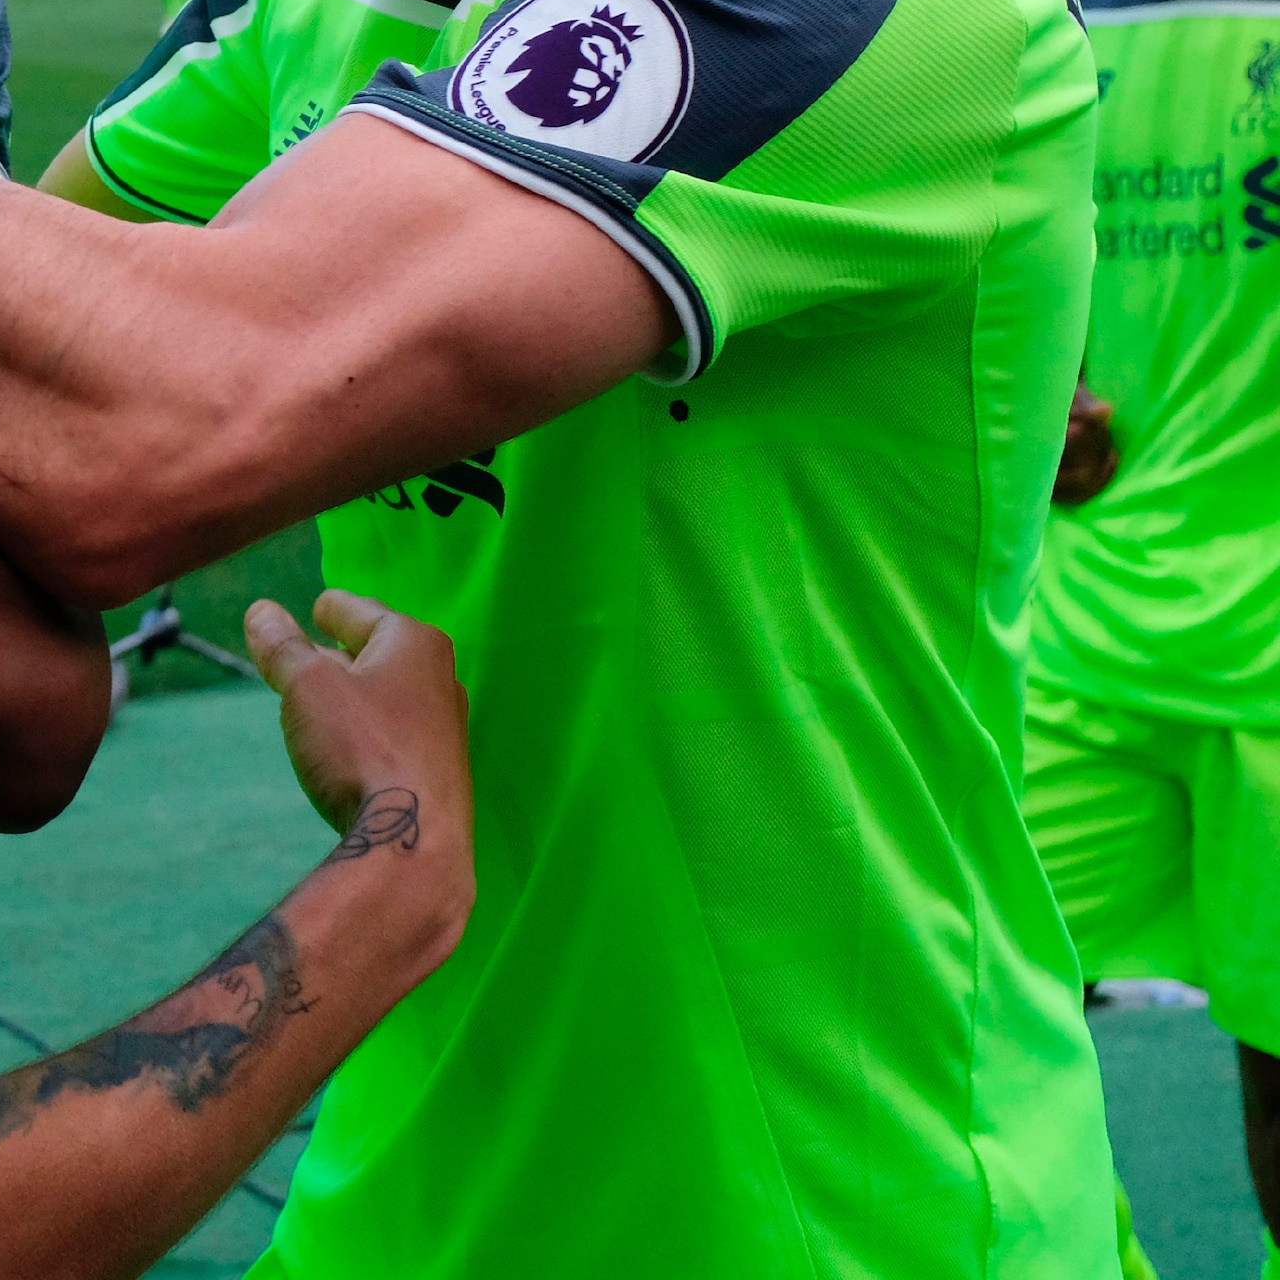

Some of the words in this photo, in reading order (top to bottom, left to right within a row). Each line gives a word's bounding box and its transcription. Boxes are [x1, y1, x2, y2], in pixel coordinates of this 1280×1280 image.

[472, 26, 519, 78] Premier
[470, 79, 508, 132] League
[1093, 153, 1224, 203] andard
[1095, 212, 1224, 258] artered
